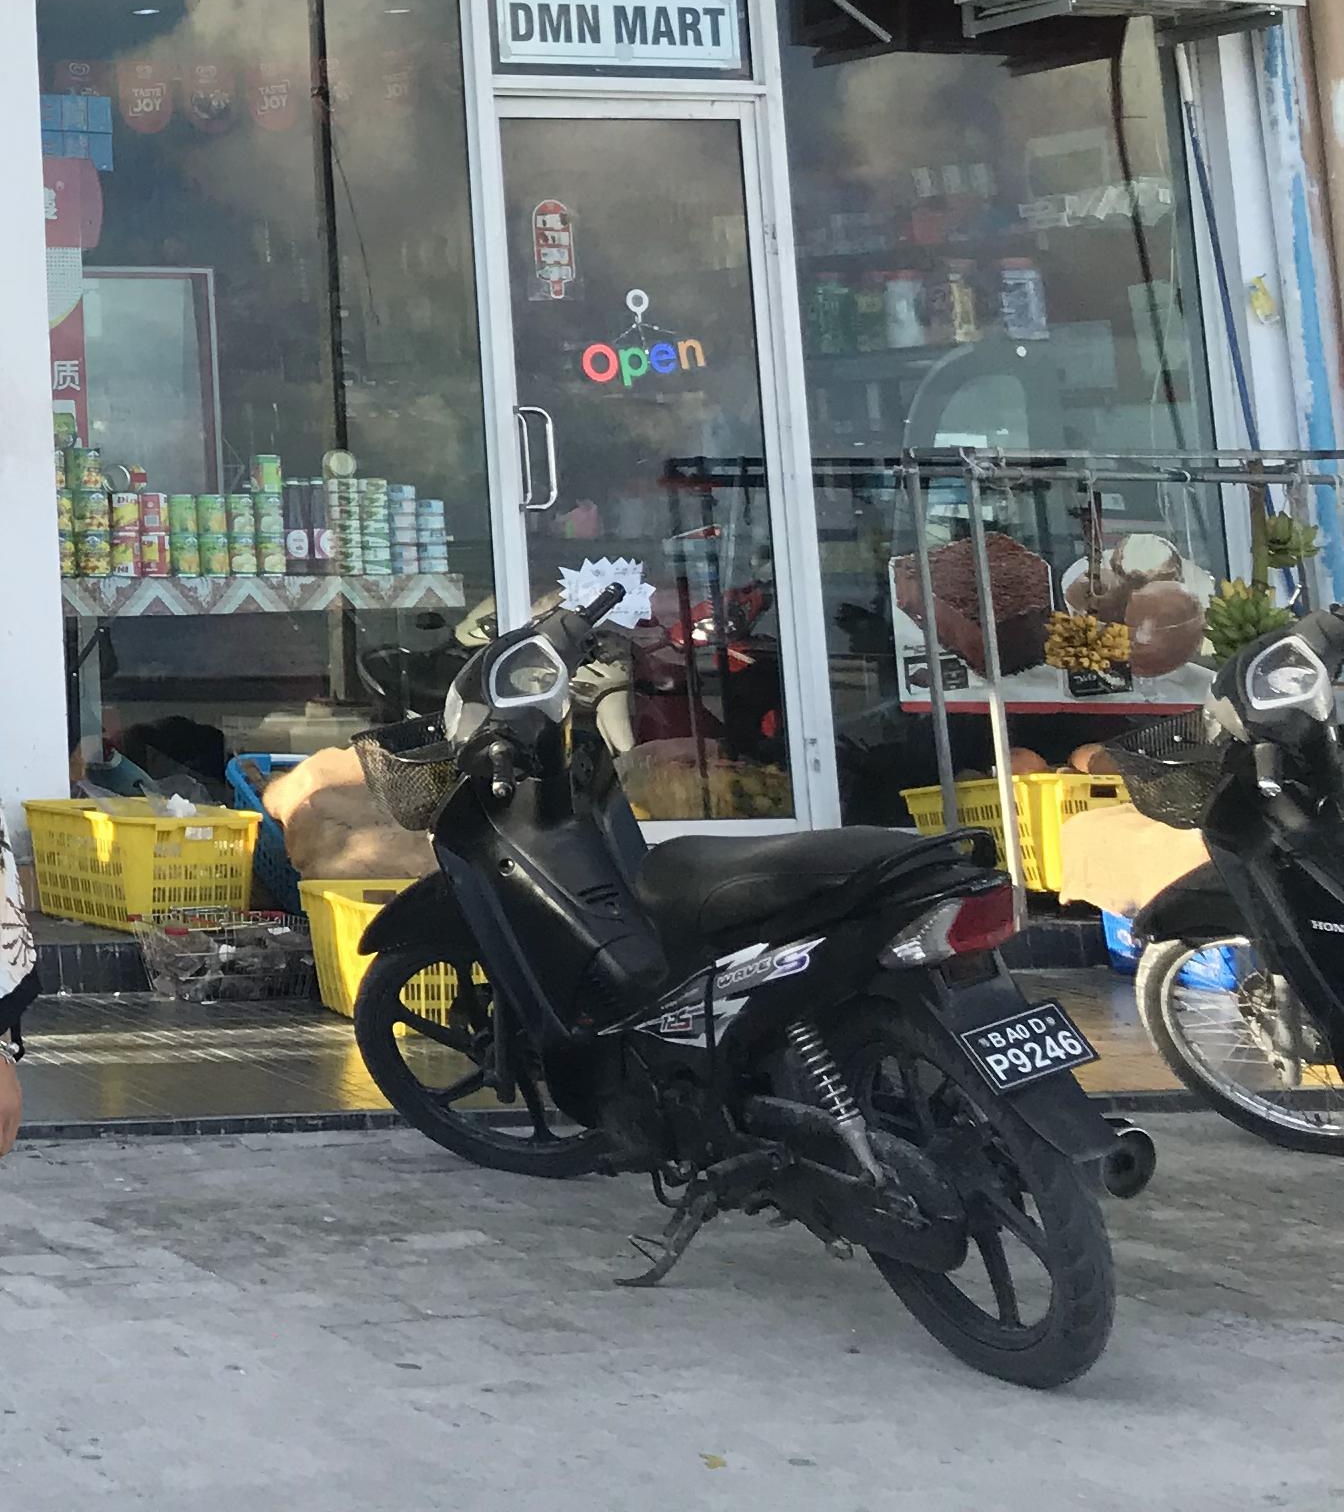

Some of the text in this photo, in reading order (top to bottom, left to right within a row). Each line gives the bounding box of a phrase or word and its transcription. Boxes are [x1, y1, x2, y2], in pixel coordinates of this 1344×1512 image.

[509, 1, 726, 47] DMN MART
[133, 99, 162, 112] JOY
[582, 338, 707, 387] Open
[986, 1030, 1083, 1081] P9246
